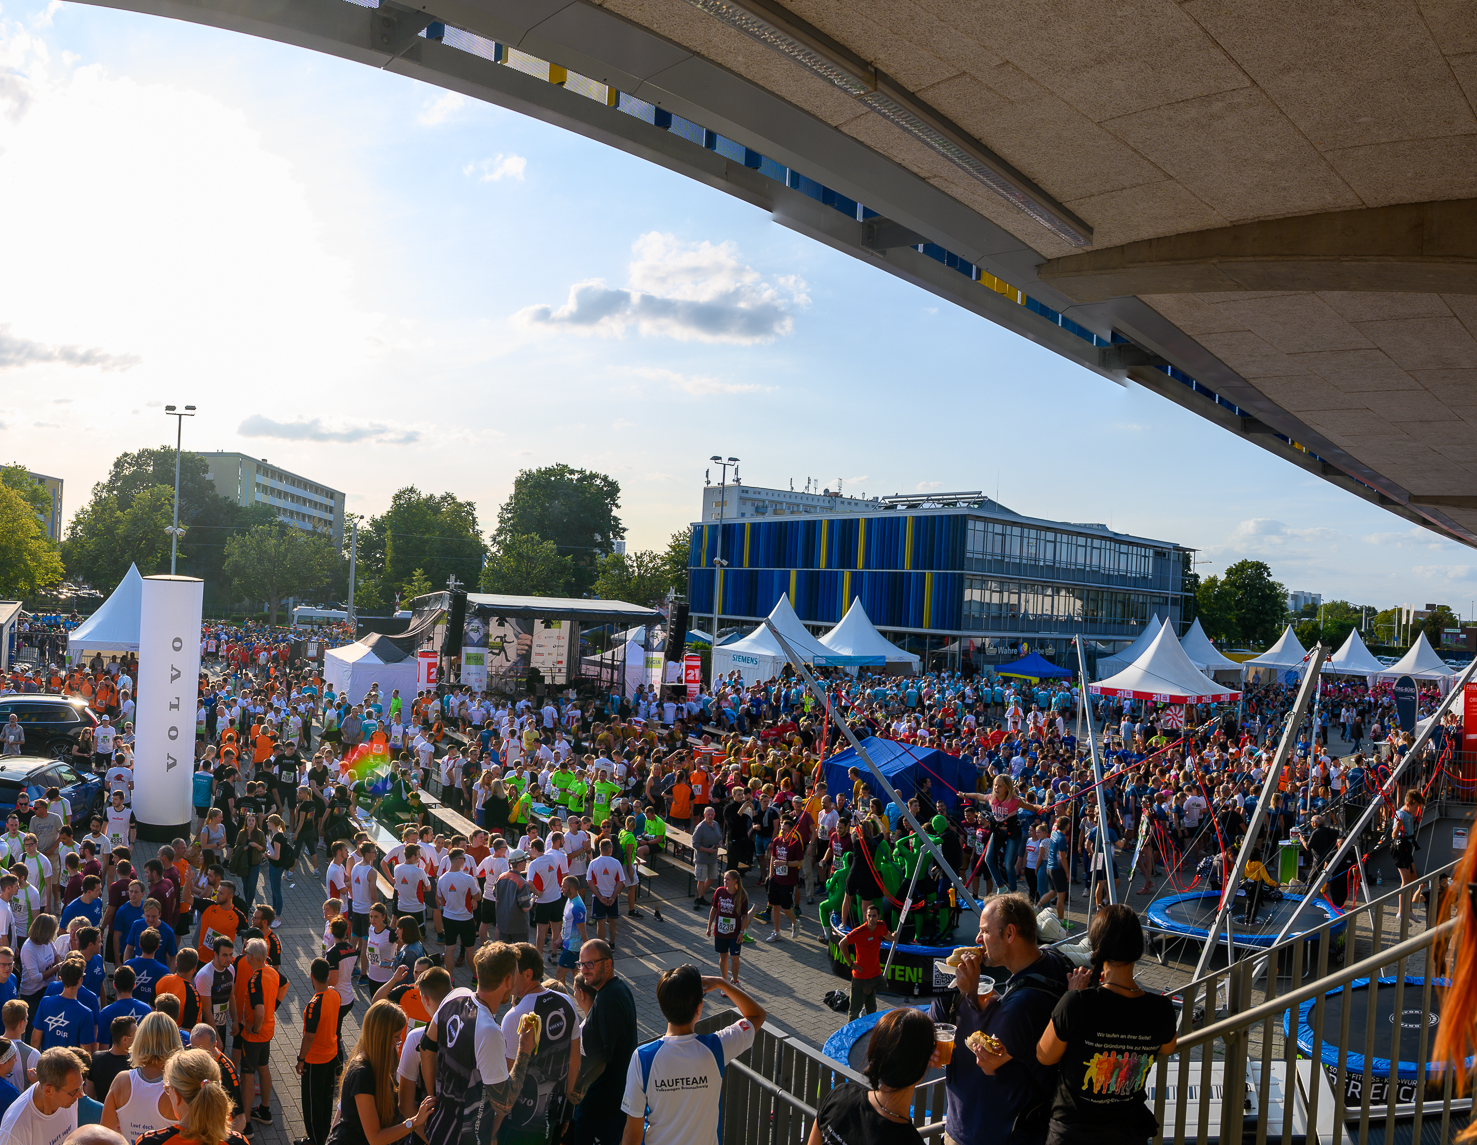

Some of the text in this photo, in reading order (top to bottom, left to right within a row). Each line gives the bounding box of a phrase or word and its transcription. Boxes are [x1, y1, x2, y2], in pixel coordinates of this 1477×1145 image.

[997, 646, 1018, 655] Wahre
[732, 653, 758, 665] SIEMENS
[686, 669, 700, 681] 21
[166, 637, 183, 772] VOLVO
[548, 1020, 564, 1031] VOLVO
[56, 1029, 68, 1039] DLR
[654, 1075, 708, 1088] LAUFTEAM
